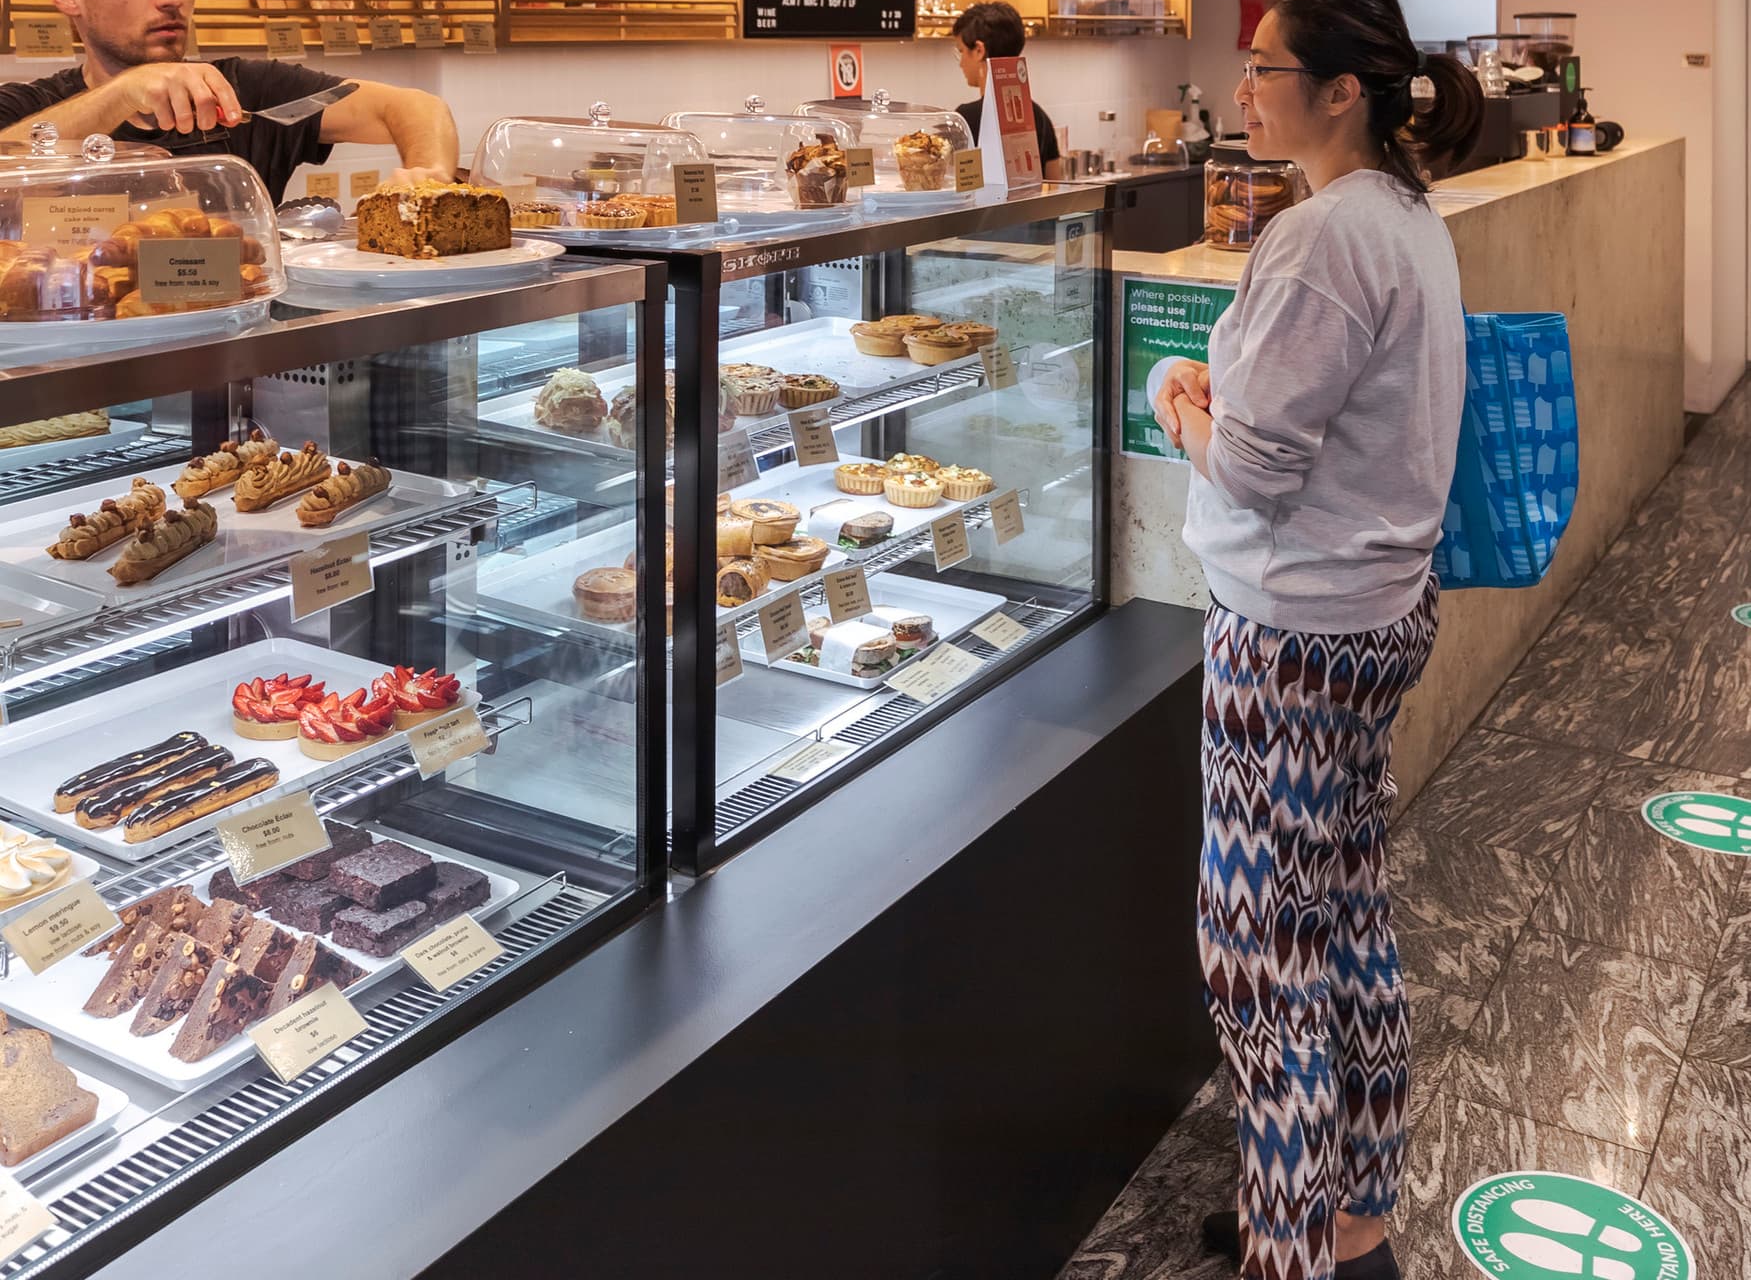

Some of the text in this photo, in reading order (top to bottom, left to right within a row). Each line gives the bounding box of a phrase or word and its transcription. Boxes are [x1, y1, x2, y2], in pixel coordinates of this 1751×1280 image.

[757, 8, 776, 17] WINE
[757, 19, 776, 28] BEER
[49, 205, 65, 213] Chai
[67, 206, 91, 214] spiced
[1130, 288, 1165, 301] Where
[1130, 302, 1186, 316] please use
[1130, 316, 1213, 333] contactless pay
[242, 819, 274, 833] Chocolate
[22, 899, 80, 937] Lemon meringue
[415, 949, 428, 958] Dark
[273, 1000, 327, 1034] Decadent hazelnut
[295, 1017, 319, 1033] brownie
[1467, 1179, 1536, 1272] SAFE DISTANCING
[1617, 1203, 1666, 1238] HERE
